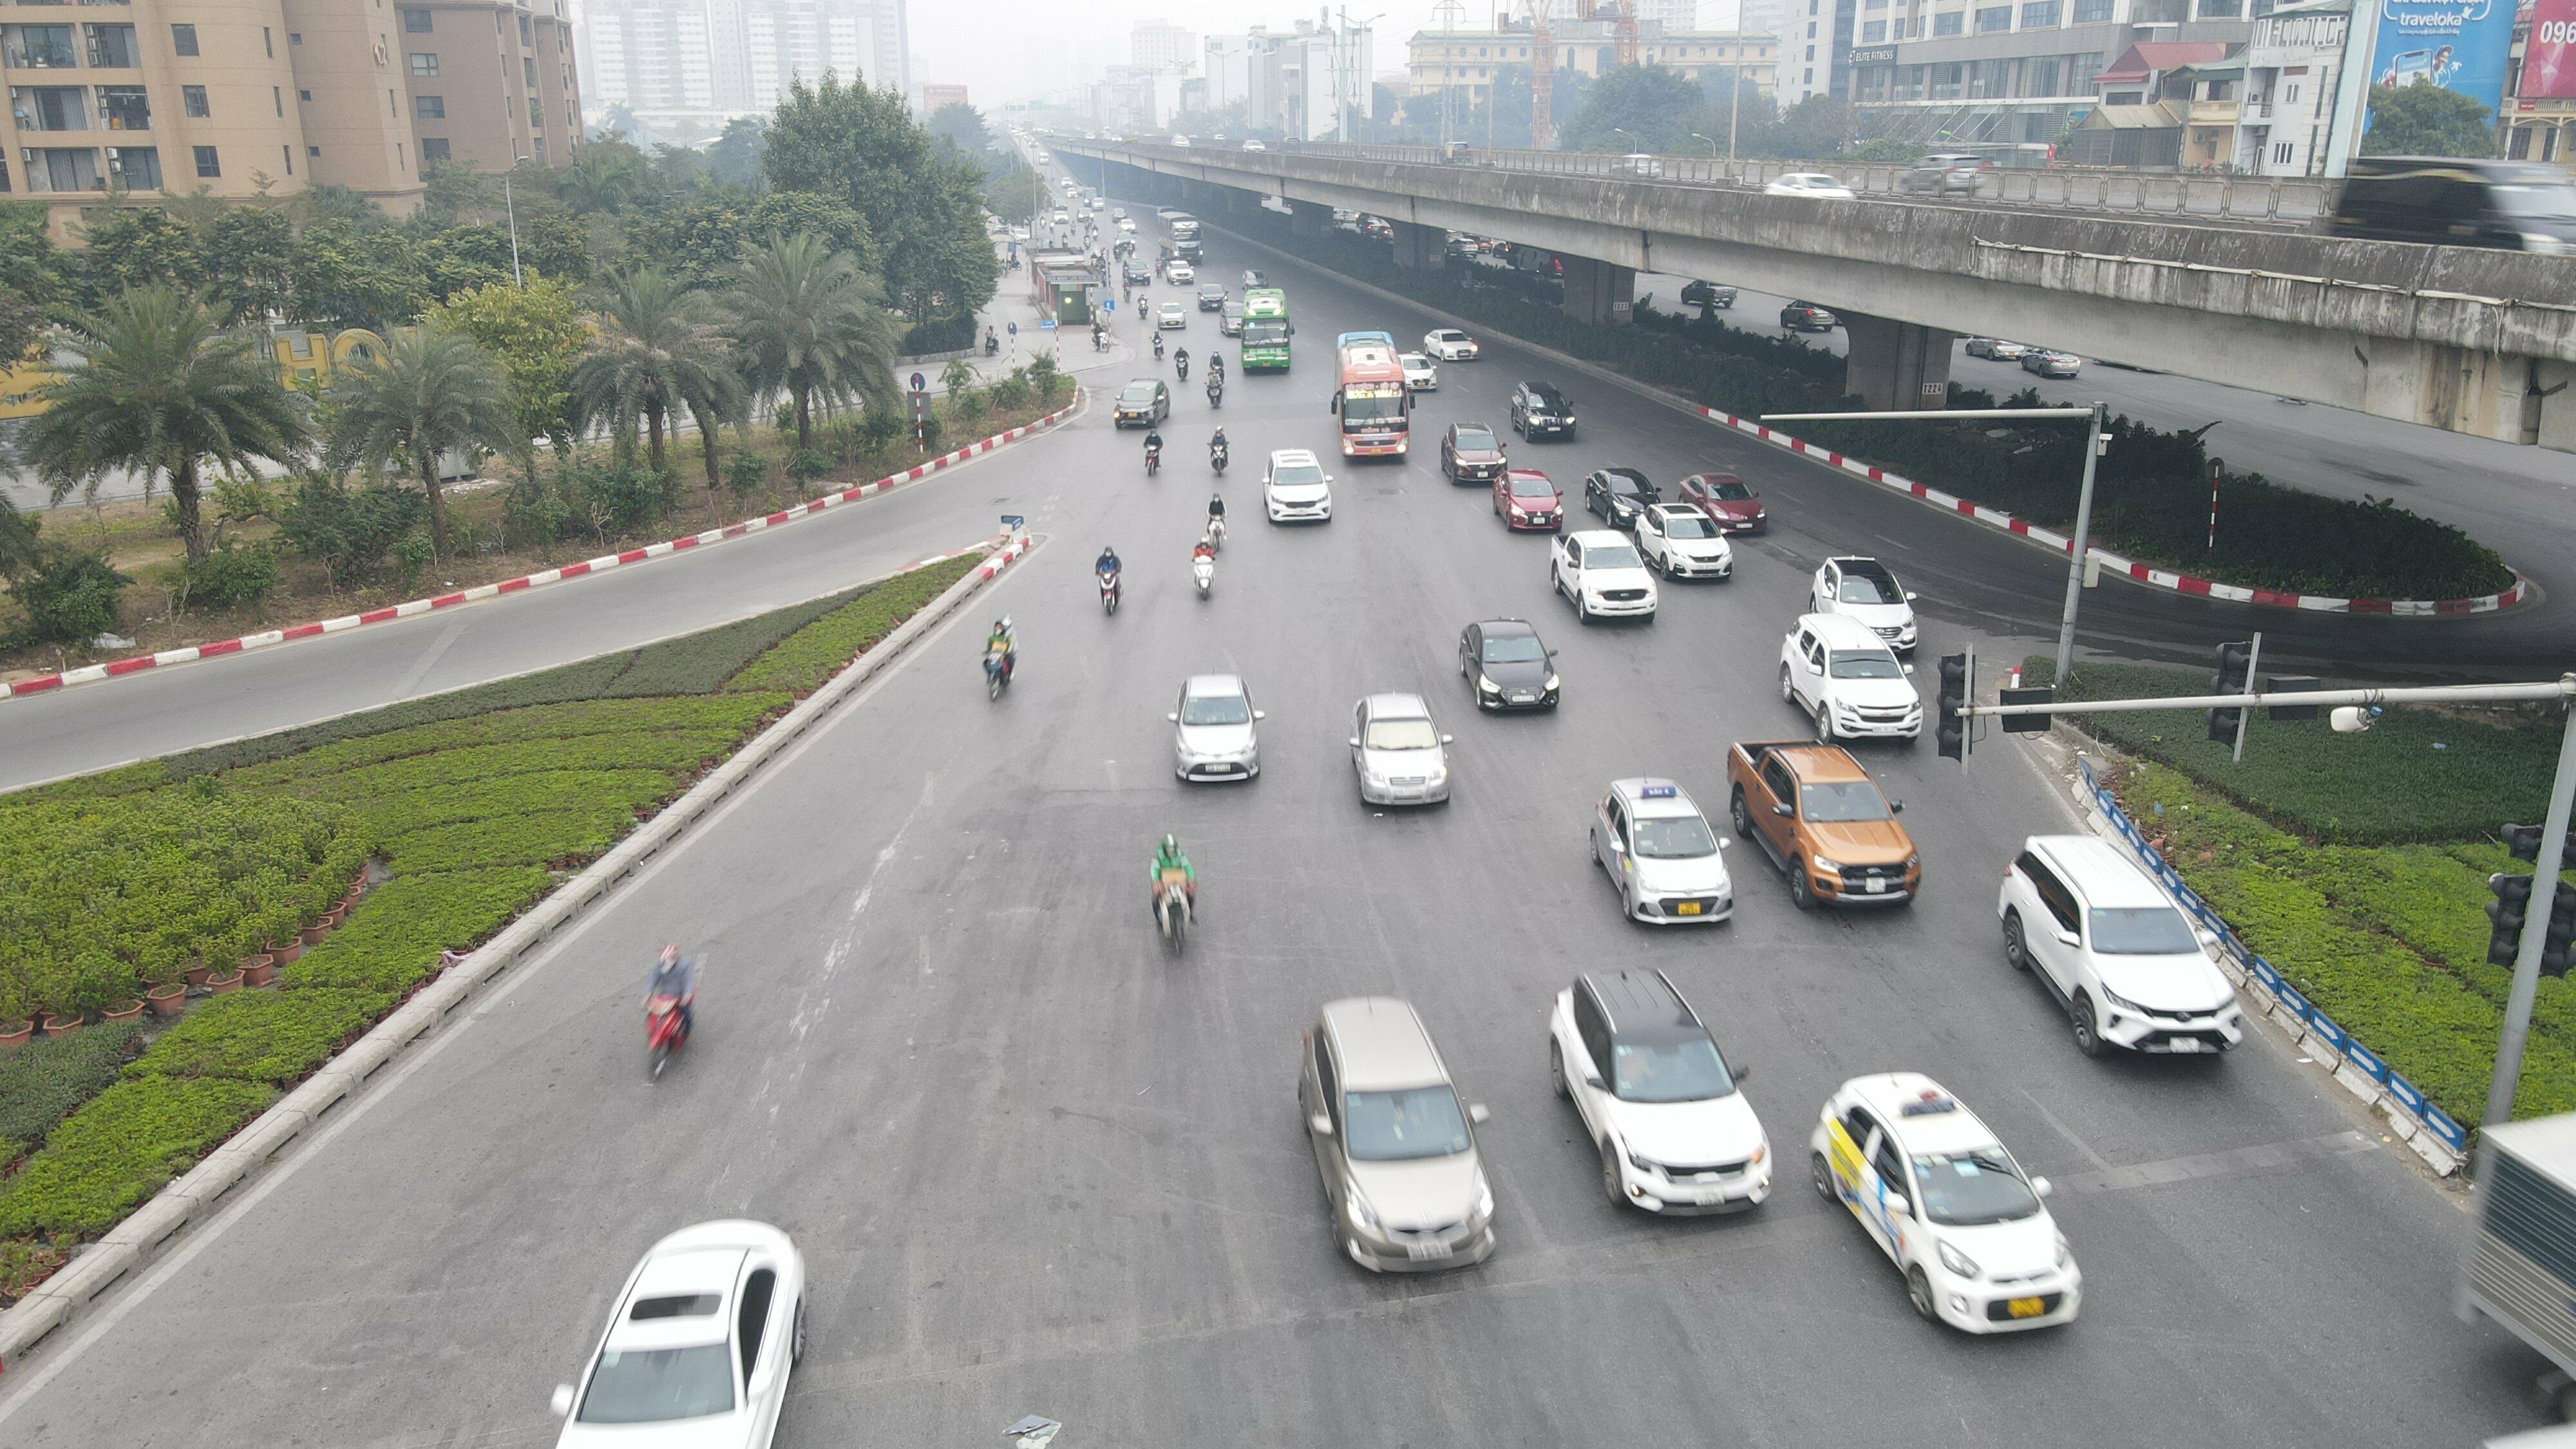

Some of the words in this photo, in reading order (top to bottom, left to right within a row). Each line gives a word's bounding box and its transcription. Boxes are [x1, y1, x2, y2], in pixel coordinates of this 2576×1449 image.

[2400, 12, 2462, 26] traveloka
[2540, 21, 2576, 44] 096
[1855, 52, 1871, 62] ELITE
[1871, 50, 1893, 61] FITNESS
[1924, 384, 1941, 393] T224
